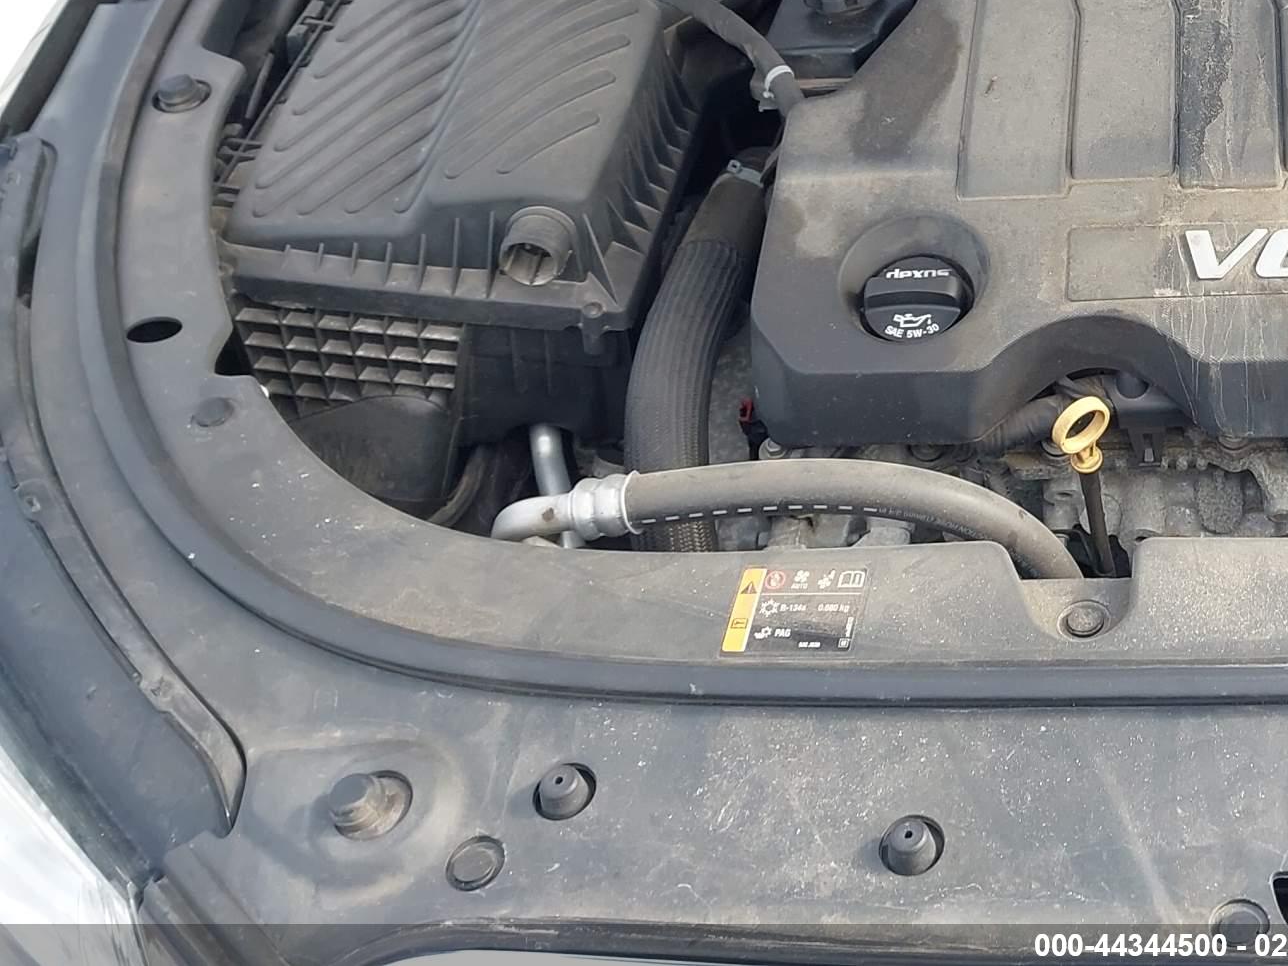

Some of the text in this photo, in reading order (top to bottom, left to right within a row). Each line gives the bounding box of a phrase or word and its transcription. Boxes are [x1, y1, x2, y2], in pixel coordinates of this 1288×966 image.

[885, 324, 939, 338] SAE 5W-30
[774, 628, 791, 637] PAG
